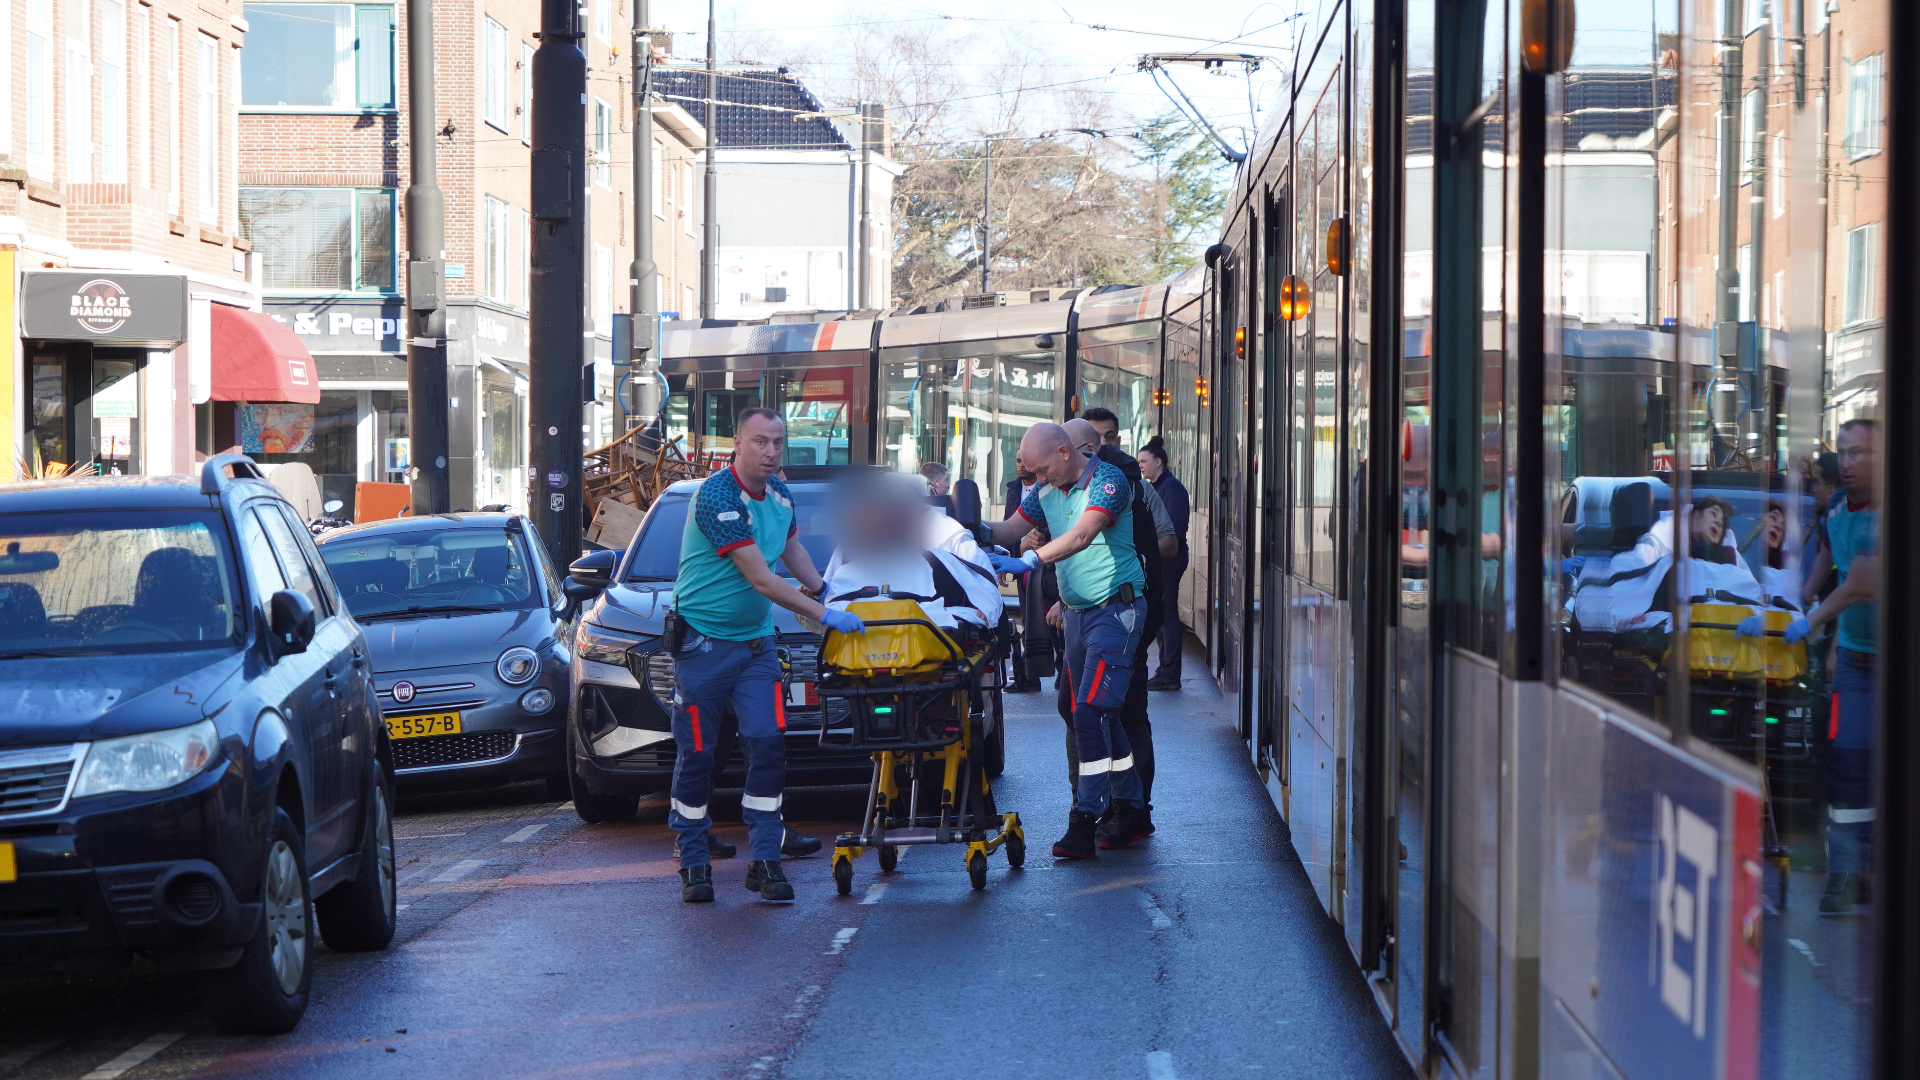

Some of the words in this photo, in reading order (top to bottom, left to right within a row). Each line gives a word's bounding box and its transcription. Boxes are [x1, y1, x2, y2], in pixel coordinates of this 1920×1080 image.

[71, 295, 131, 308] BLACK
[70, 306, 133, 318] DIAMOND
[293, 313, 321, 335] &
[865, 652, 899, 661] 17-139
[397, 687, 410, 698] FIAT
